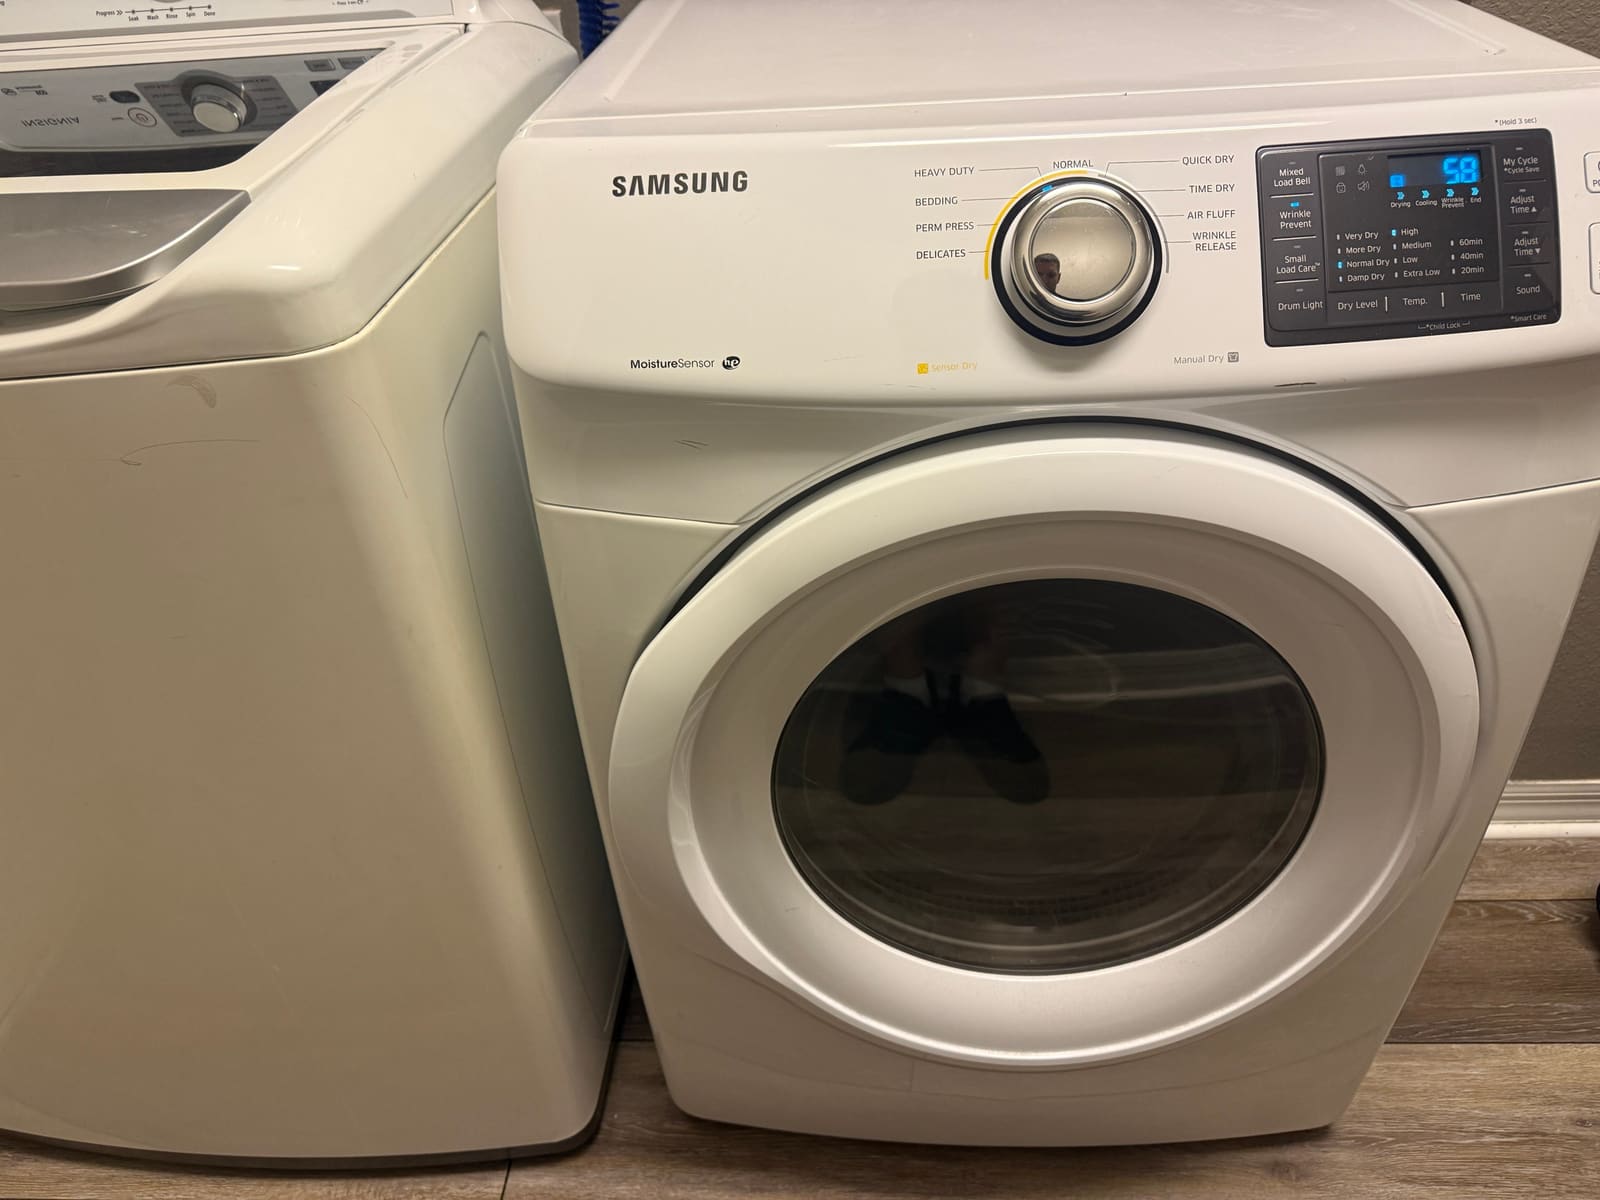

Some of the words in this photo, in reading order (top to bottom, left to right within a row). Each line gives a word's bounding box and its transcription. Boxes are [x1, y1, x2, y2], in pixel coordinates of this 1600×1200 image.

[1053, 159, 1094, 169] NORMAL
[1182, 156, 1212, 166] QUICK
[1215, 154, 1235, 164] DRY
[1503, 158, 1516, 167] My
[1517, 156, 1539, 166] Cycle
[914, 168, 946, 178] HEAVY
[949, 166, 975, 176] DUTY
[1279, 167, 1304, 177] Mixed
[1443, 156, 1478, 185] 58
[611, 170, 749, 198] SAMSUNG
[1295, 177, 1311, 186] Bell
[1188, 184, 1213, 194] TIME
[1215, 183, 1236, 193] DRY
[915, 196, 959, 207] BEDDING
[1415, 199, 1438, 207] Cooling
[1510, 194, 1535, 205] Adjust
[1187, 210, 1204, 220] AIR
[1206, 209, 1236, 219] FLUFF
[1279, 209, 1312, 220] Wrinkle
[1510, 205, 1530, 214] Time
[915, 223, 943, 233] PERM
[945, 221, 975, 231] PRESS
[1280, 220, 1312, 230] Prevent
[1192, 230, 1237, 241] WRINKLE
[1344, 232, 1363, 241] Very
[1364, 230, 1379, 240] Dry
[1401, 227, 1419, 237] High
[1195, 241, 1237, 252] RELEASE
[1401, 240, 1432, 250] Medium
[1459, 237, 1483, 246] 60min
[1514, 236, 1539, 247] Adjust
[916, 248, 966, 260] DELICATES
[1346, 246, 1366, 255] More
[1366, 244, 1382, 254] Dry
[1514, 248, 1534, 256] Time
[1284, 254, 1307, 264] Small
[1402, 256, 1418, 264] Low
[1459, 251, 1484, 260] 40min
[1346, 258, 1375, 268] Normal
[1375, 258, 1391, 268] Dry
[1276, 265, 1297, 275] Load
[1403, 269, 1425, 278] Extra
[1424, 268, 1441, 277] Low
[1460, 265, 1485, 275] 20min
[1347, 274, 1370, 283] Damp
[1371, 272, 1386, 282] Dry
[1516, 284, 1541, 295] Sound
[1403, 297, 1429, 307] Temp.
[1460, 293, 1482, 302] Time
[1278, 301, 1301, 311] Drum
[1301, 299, 1324, 311] Light
[1337, 301, 1354, 312] Dry
[1355, 299, 1379, 310] Level
[1532, 313, 1548, 321] Care
[1446, 321, 1461, 330] Lock
[630, 358, 715, 369] MoistureSensor
[1173, 355, 1206, 364] Manual
[1208, 354, 1225, 364] Dry
[962, 360, 978, 370] Dry
